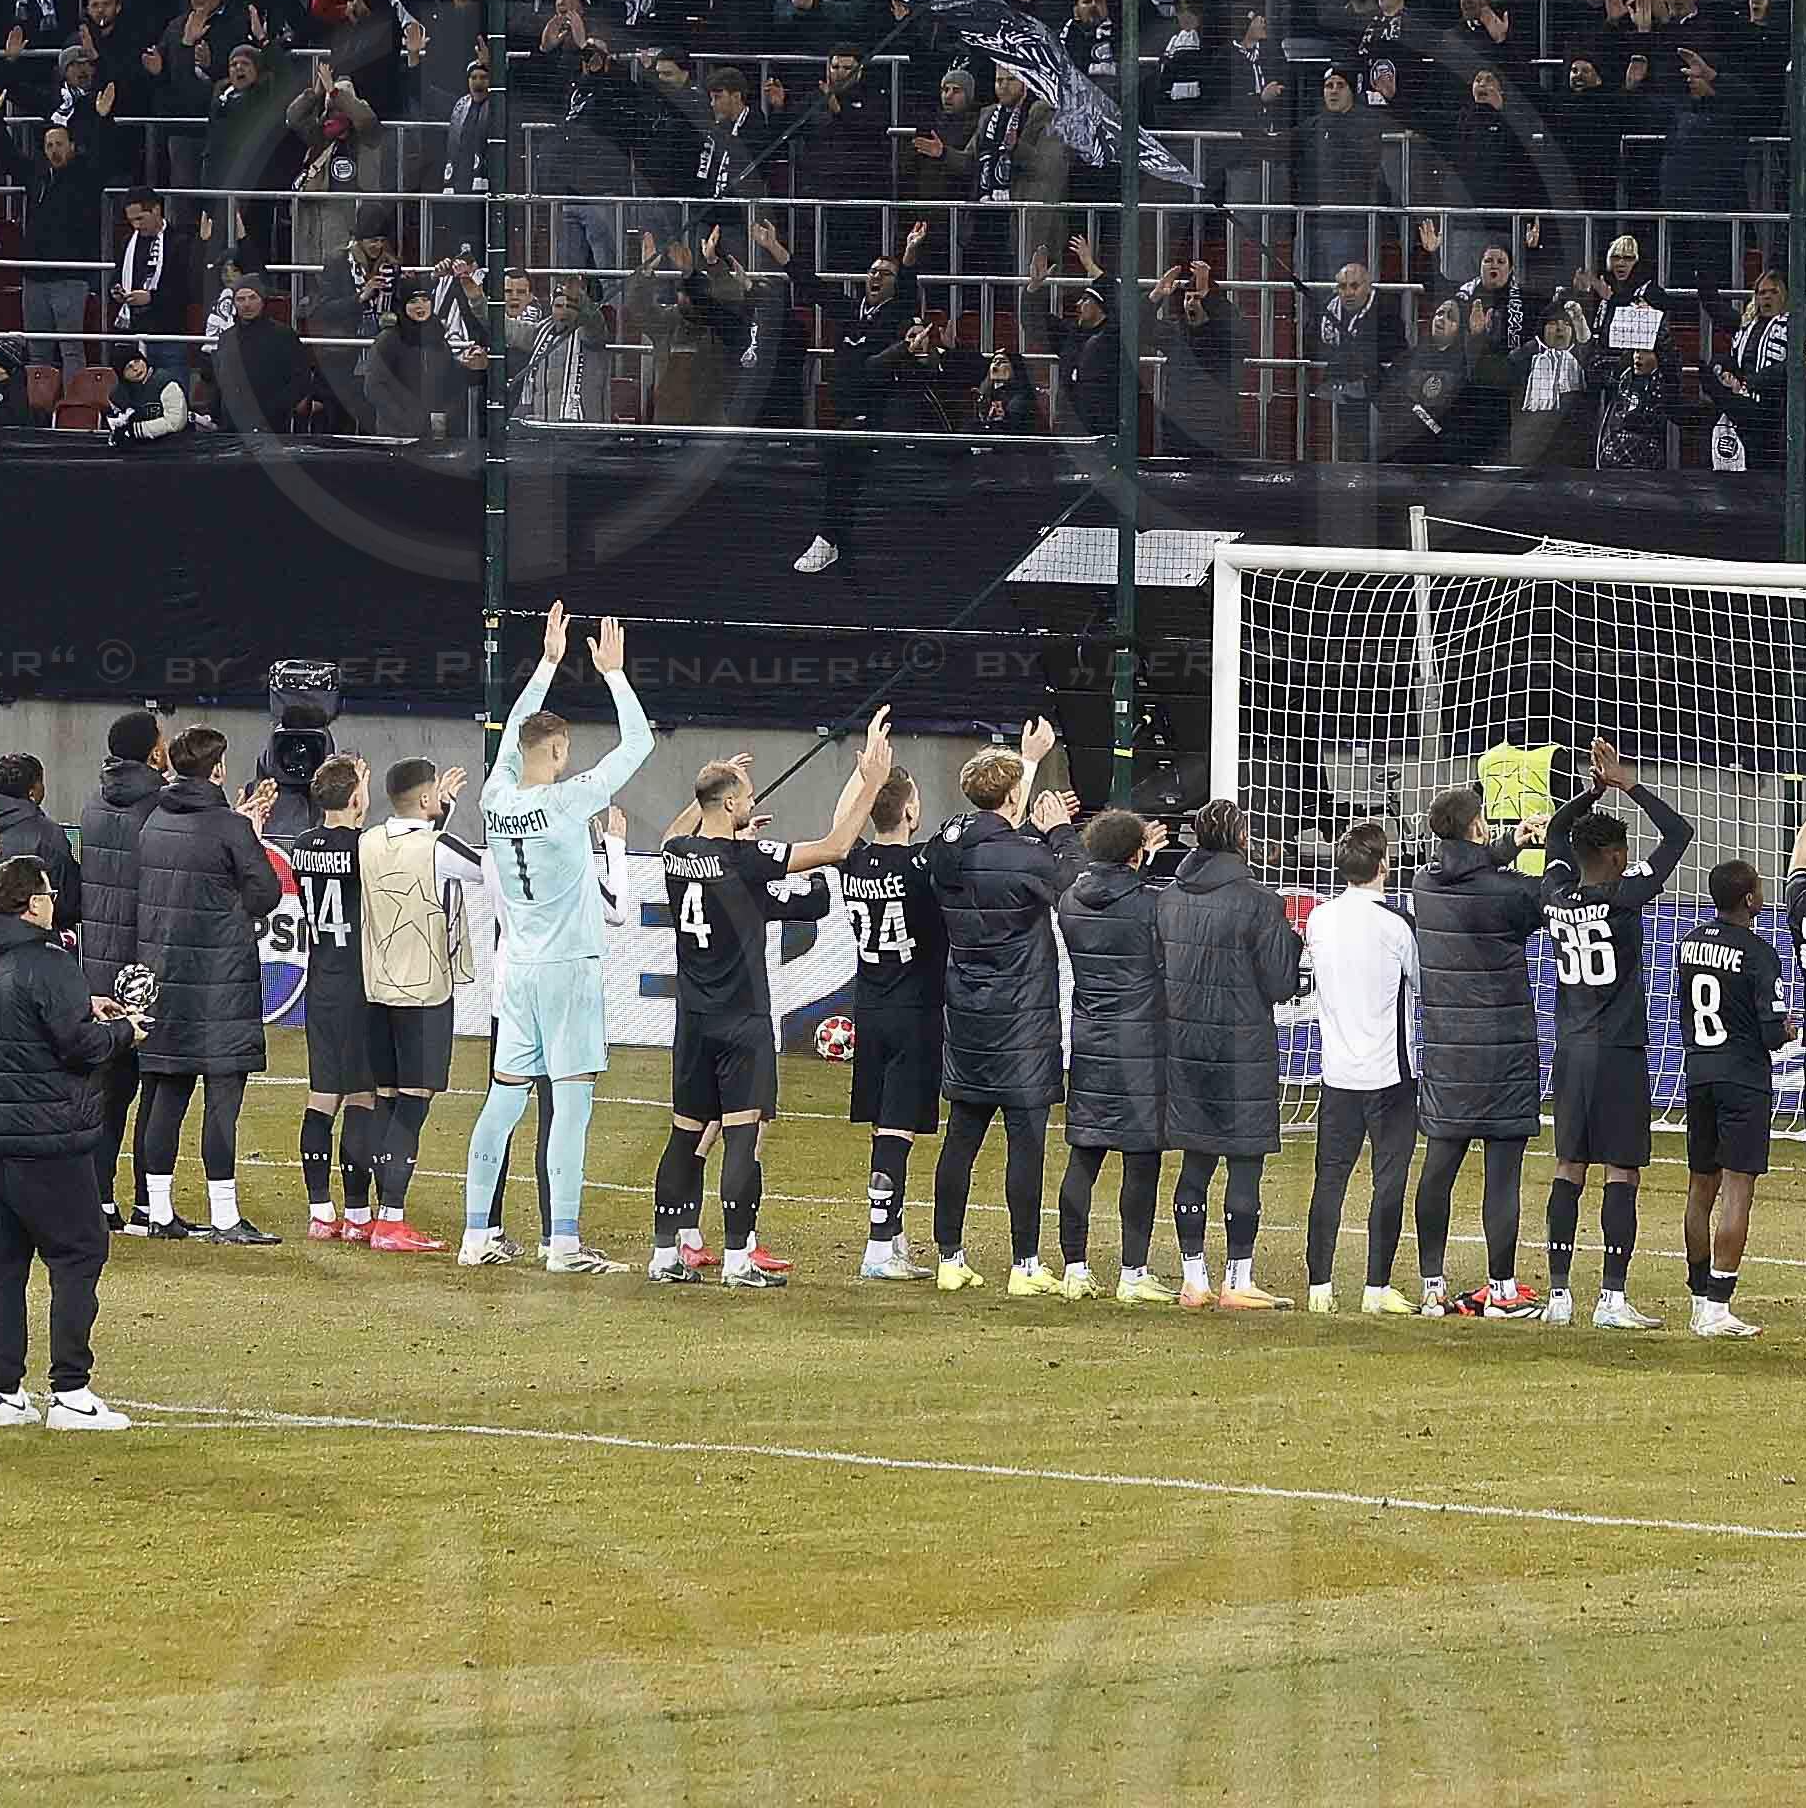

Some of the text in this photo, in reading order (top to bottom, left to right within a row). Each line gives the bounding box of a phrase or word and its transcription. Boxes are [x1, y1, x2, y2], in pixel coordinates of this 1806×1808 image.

[487, 805, 549, 836] SCHERPEN
[511, 838, 535, 901] 1
[842, 871, 907, 901] LAVALÉE
[299, 876, 352, 948] 14
[680, 880, 713, 950] 4
[843, 900, 917, 965] 24
[1548, 919, 1617, 987] 36
[1691, 972, 1728, 1047] 8
